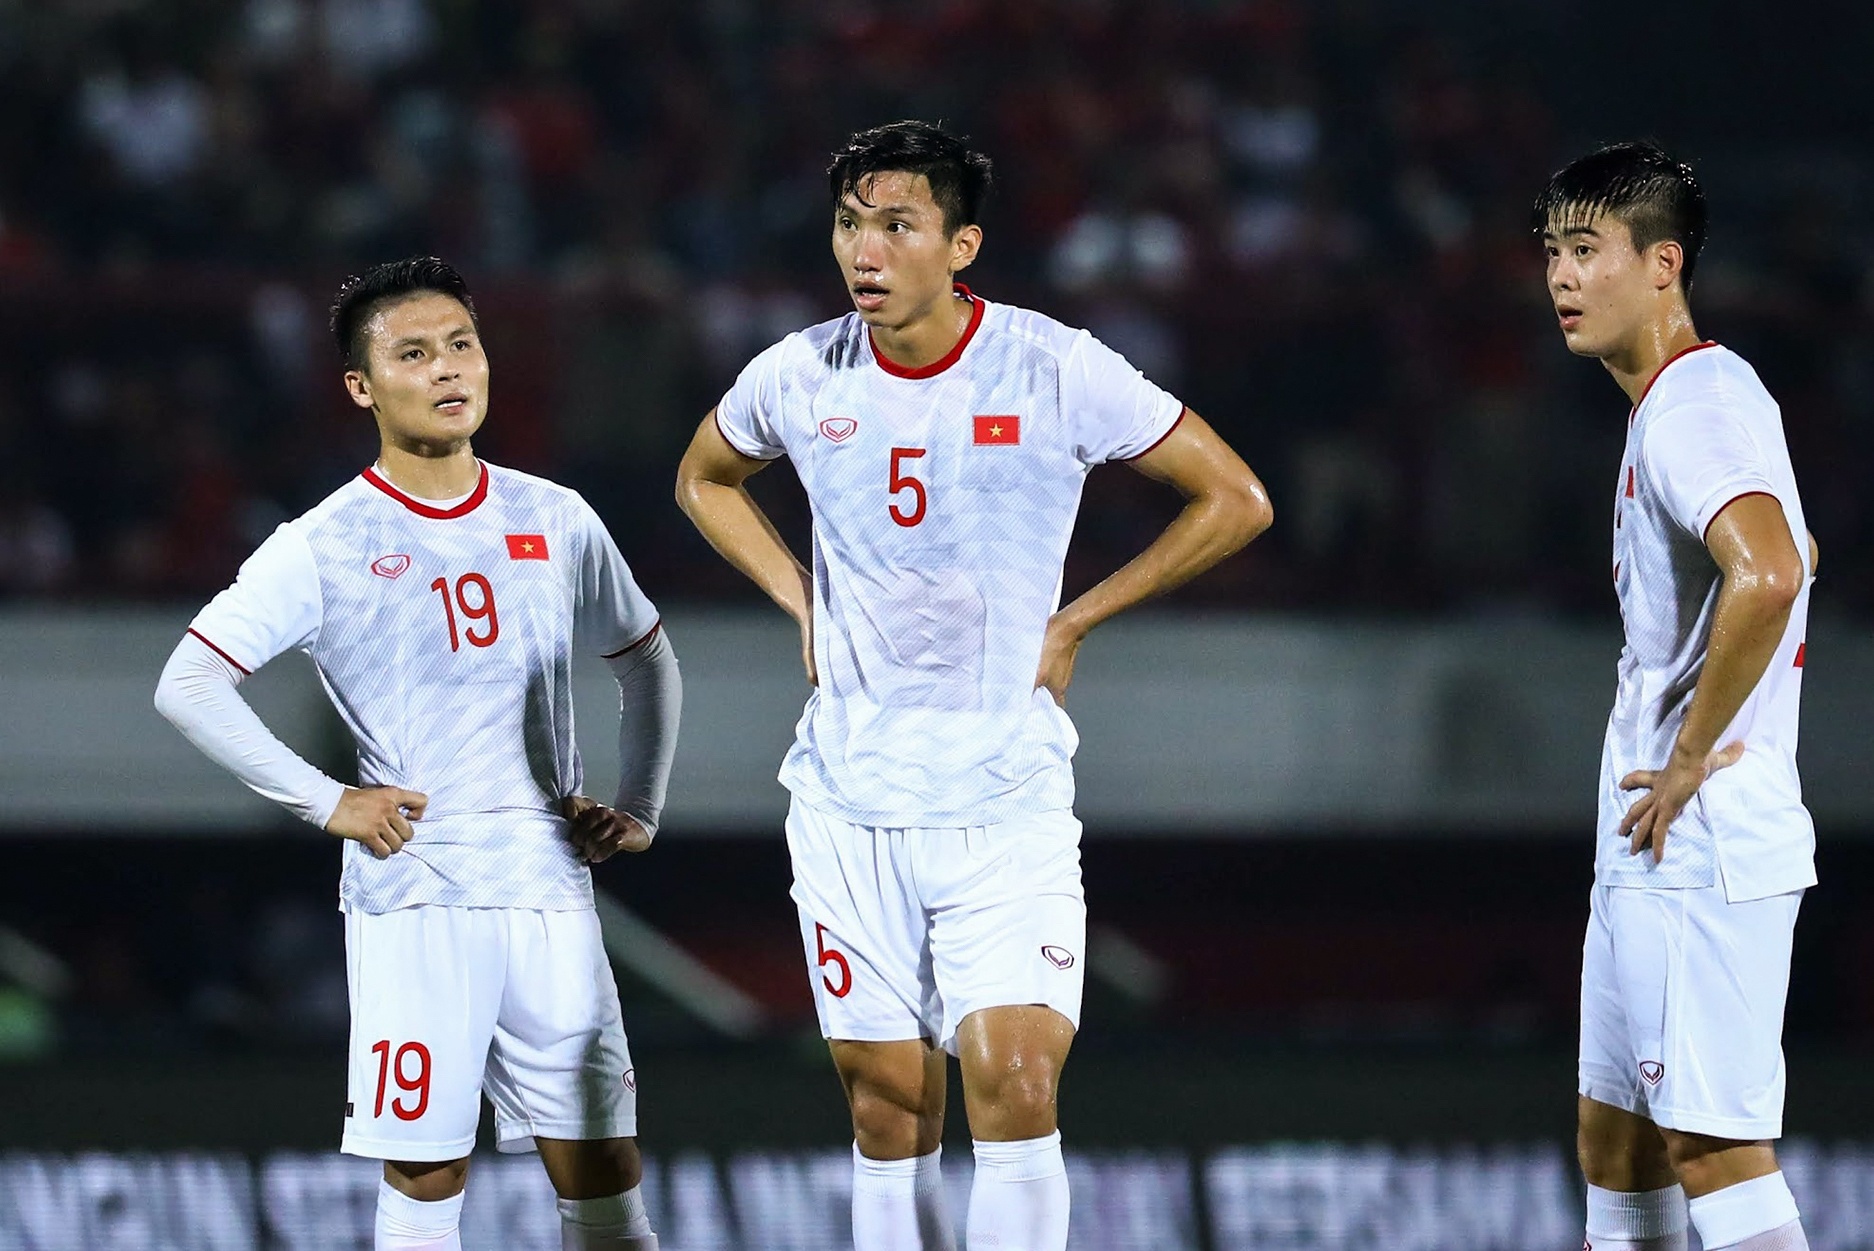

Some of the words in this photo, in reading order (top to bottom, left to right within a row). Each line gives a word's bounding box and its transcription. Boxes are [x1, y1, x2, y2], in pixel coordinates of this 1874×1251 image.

[889, 447, 927, 528] 5
[431, 572, 499, 652] 19
[815, 921, 852, 998] 5
[371, 1040, 432, 1121] 19
